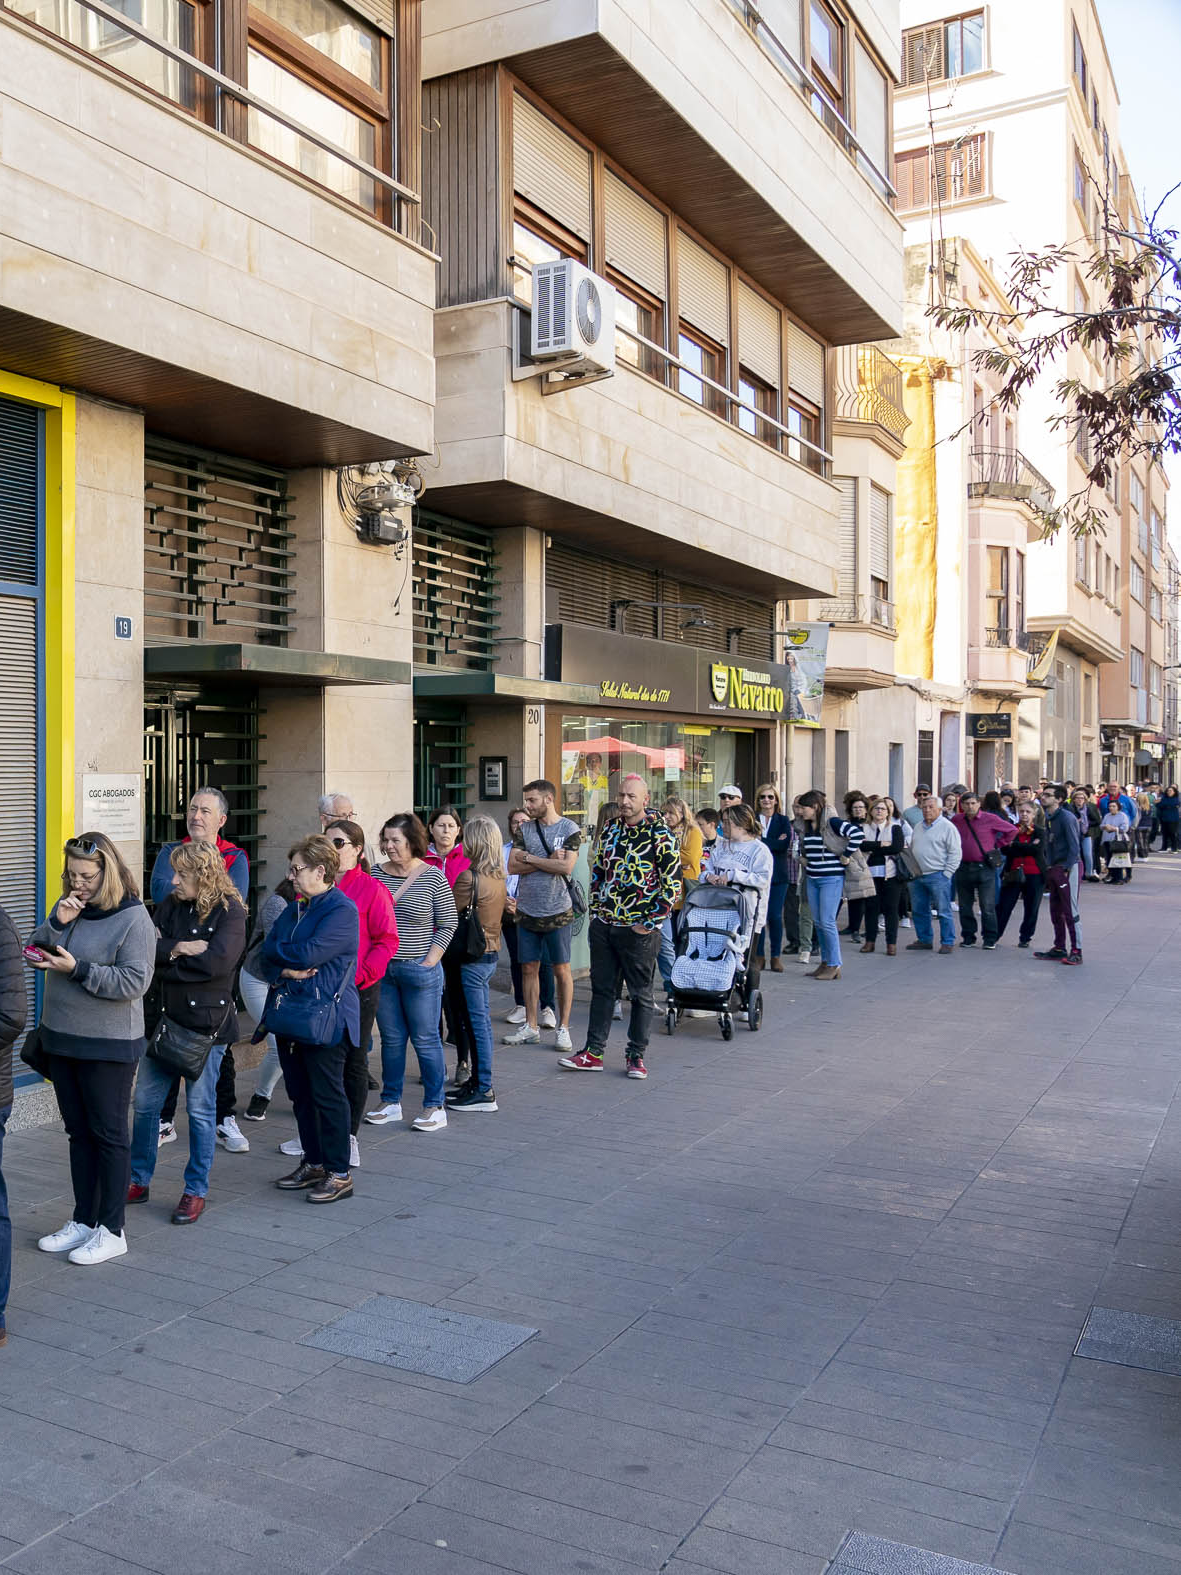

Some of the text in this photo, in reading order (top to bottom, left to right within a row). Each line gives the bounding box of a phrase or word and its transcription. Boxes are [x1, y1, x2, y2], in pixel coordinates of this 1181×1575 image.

[120, 620, 128, 634] 19
[600, 680, 618, 698] Salut
[618, 682, 643, 700] Natural
[729, 666, 784, 713] Navarro
[528, 708, 539, 724] 20
[89, 789, 135, 798] CGC ABOGADOS
